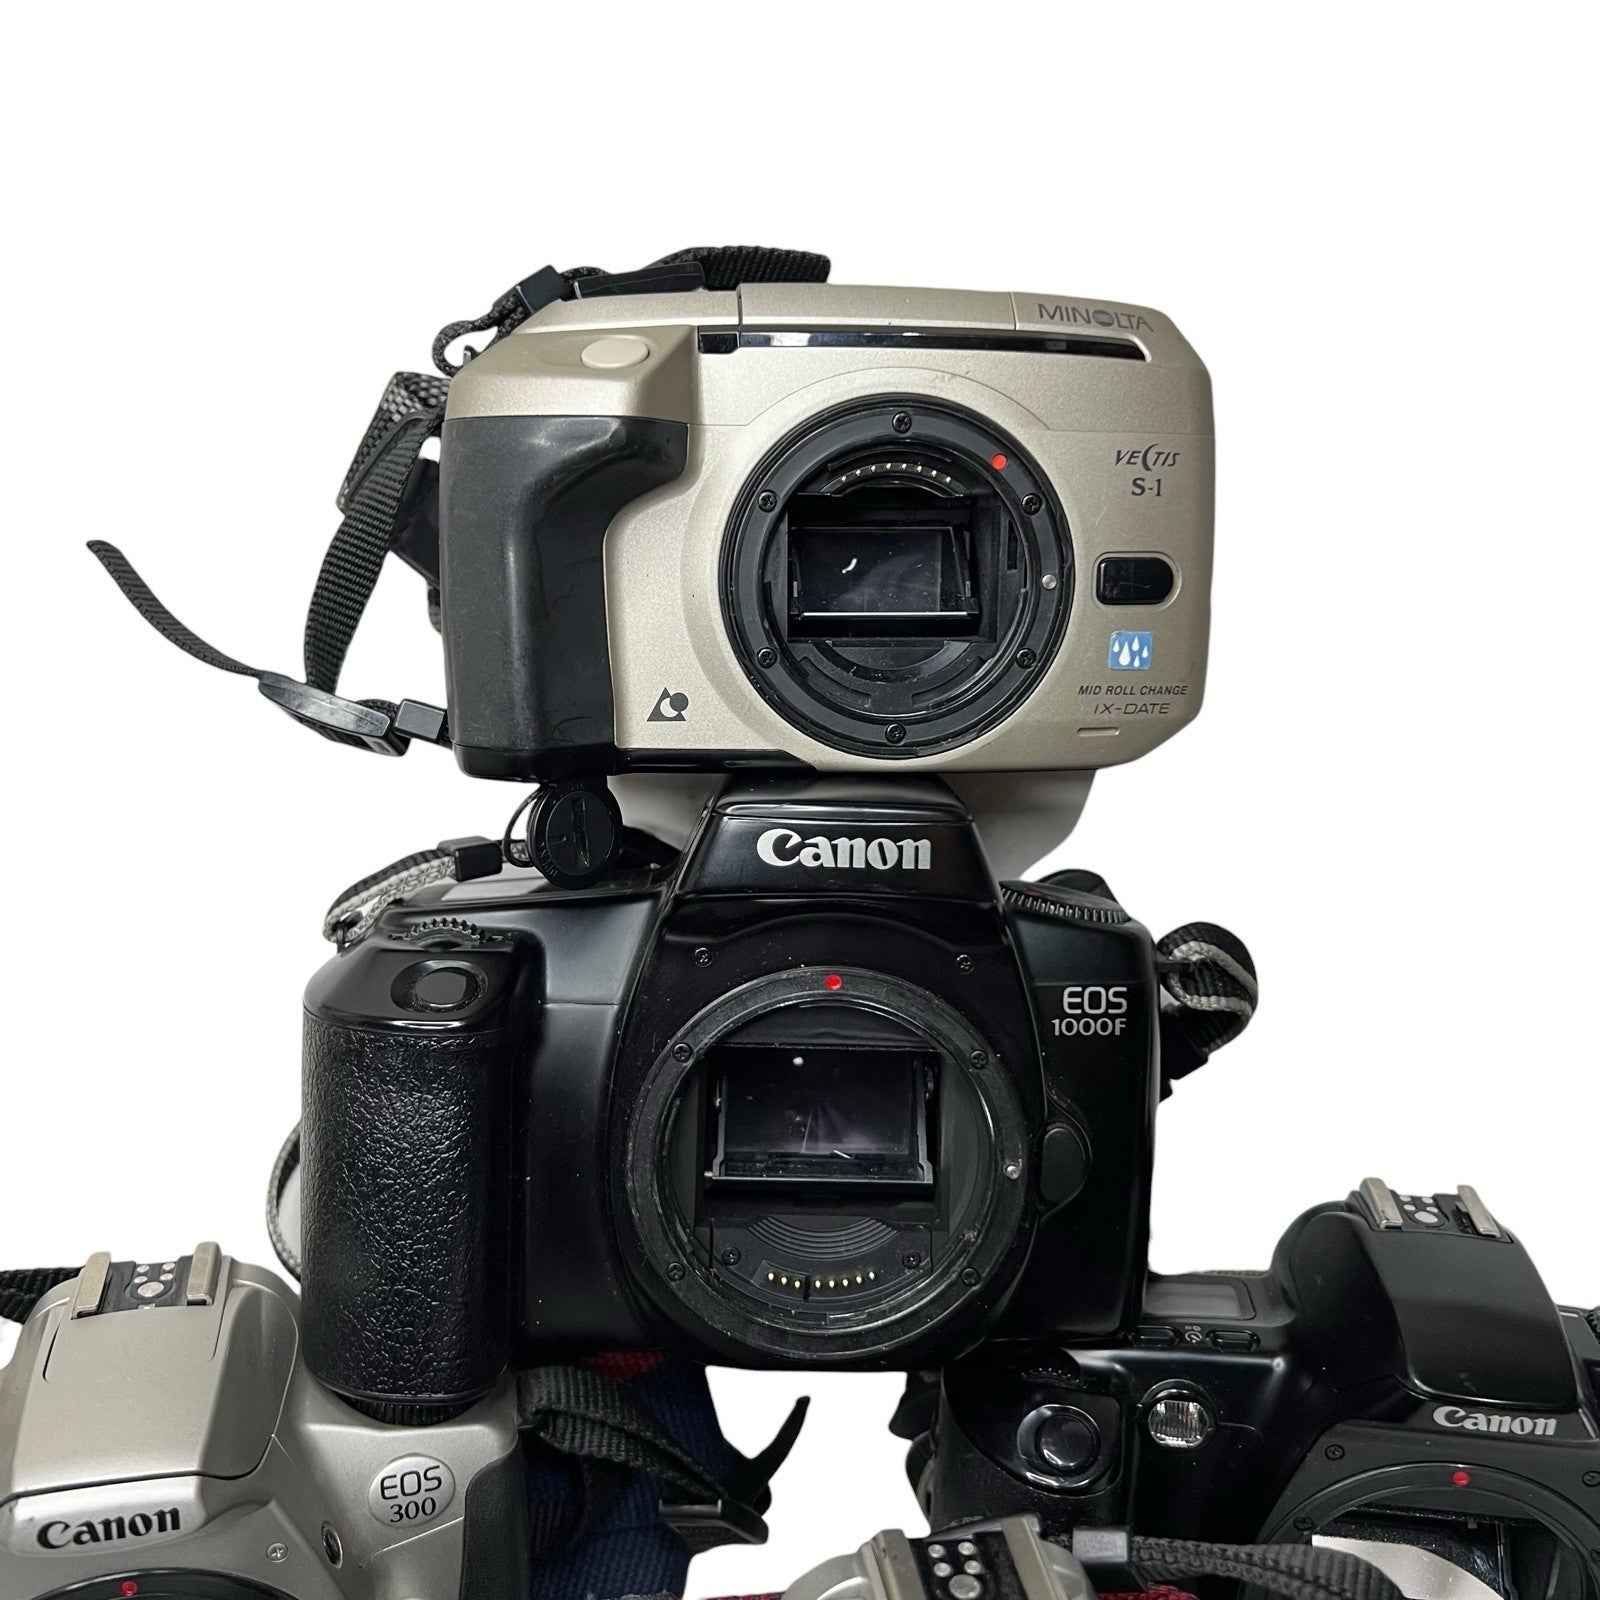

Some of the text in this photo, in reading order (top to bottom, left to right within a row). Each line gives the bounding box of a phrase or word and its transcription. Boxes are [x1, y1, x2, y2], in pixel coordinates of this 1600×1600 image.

[1037, 304, 1154, 332] MINOLTA
[1115, 444, 1181, 472] VECTIS
[1131, 477, 1163, 498] S-1
[1078, 685, 1188, 696] MID ROLL CHANGE
[1093, 703, 1170, 716] IX-DATE
[756, 828, 932, 871] Canon
[1062, 986, 1128, 1015] EOS
[1051, 1017, 1127, 1037] 1000F
[1433, 1405, 1557, 1437] Canon
[380, 1464, 443, 1499] EOS
[389, 1496, 437, 1523] 300
[36, 1506, 181, 1550] Canon
